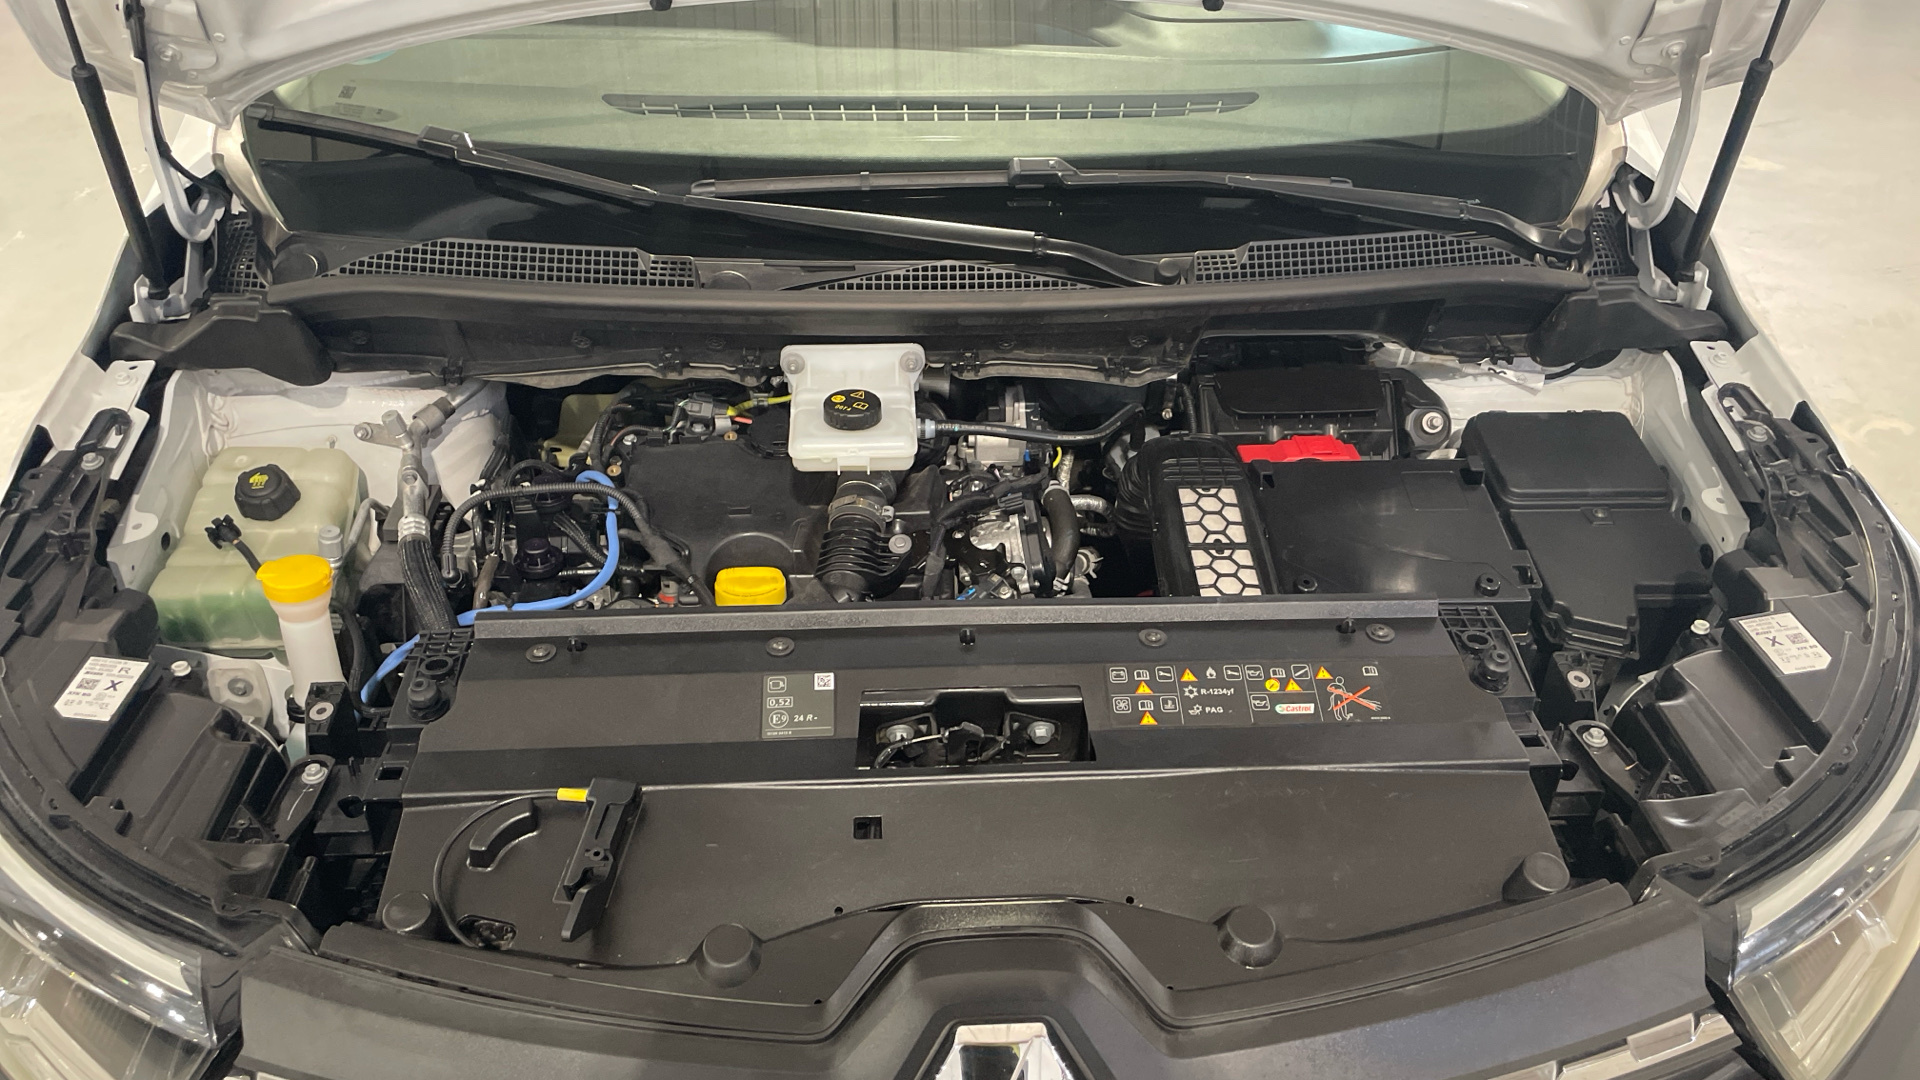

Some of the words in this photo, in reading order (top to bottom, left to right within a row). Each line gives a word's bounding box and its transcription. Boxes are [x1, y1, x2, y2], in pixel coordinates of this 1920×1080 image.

[1764, 635, 1785, 647] X
[103, 680, 123, 691] X
[1200, 688, 1234, 696] R-1234yf
[769, 698, 791, 707] 0,52
[1205, 706, 1224, 714] PAG
[1285, 705, 1312, 713] Castrol
[772, 714, 787, 724] E9
[793, 714, 804, 722] 24
